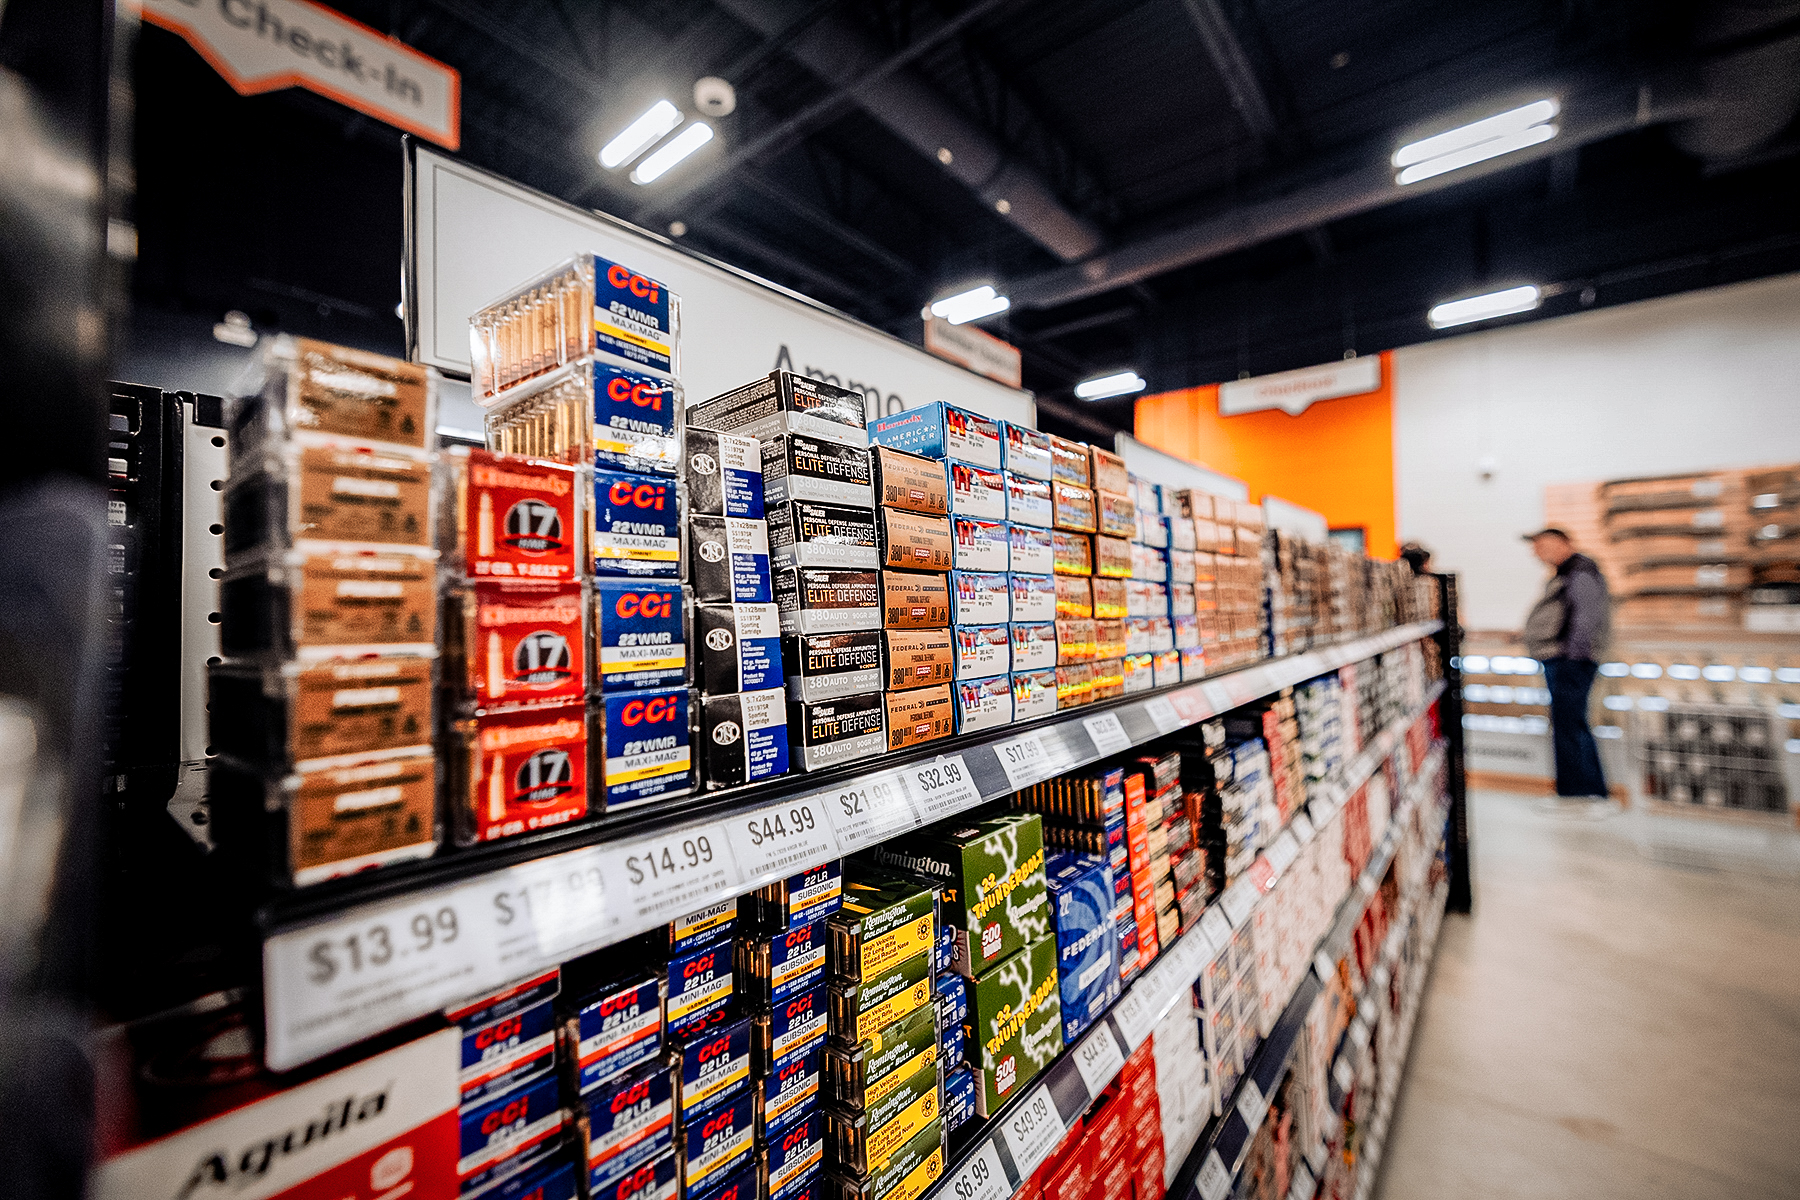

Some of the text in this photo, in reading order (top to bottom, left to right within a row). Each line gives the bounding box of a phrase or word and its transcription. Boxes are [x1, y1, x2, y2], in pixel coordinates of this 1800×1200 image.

[217, 0, 424, 108] Check-In
[877, 414, 921, 432] Hornady
[796, 457, 868, 479] ELITE DEFENSE
[517, 504, 557, 536] 17
[804, 523, 874, 540] ELITE DEFENSE
[808, 590, 877, 602] ELITE DEFENSE
[526, 636, 566, 670] 17
[809, 651, 877, 669] ELITE DEFENSE
[891, 704, 917, 713] FEDERAL
[813, 714, 880, 739] ELITE DEFENSE
[813, 745, 833, 758] 380
[1007, 741, 1040, 764] $17.99
[530, 752, 568, 788] 17
[918, 763, 962, 793] $32.99
[840, 783, 894, 818] $21.99
[748, 806, 814, 849] $44.99
[626, 836, 713, 884] $14.99
[874, 844, 951, 876] Remington
[798, 881, 833, 900] SUBSONIC
[804, 871, 827, 887] 22 LR
[972, 848, 1043, 919] THUNDERBOLT
[982, 873, 997, 893] 22
[493, 866, 605, 925] $1799
[686, 905, 726, 926] MINI-MAG
[864, 905, 907, 930] Remington
[308, 906, 459, 984] $13.99
[982, 923, 1000, 946] 500
[1062, 922, 1108, 961] FEDERAL
[781, 951, 818, 974] SUBSONIC
[787, 941, 811, 960] 22 LR
[680, 981, 722, 1006] MINI-MAG
[684, 970, 714, 992] 22 LR
[860, 973, 902, 1002] Remington
[788, 1010, 813, 1030] 22 LR
[987, 967, 1058, 1055] THUNDERBOLT
[996, 1004, 1012, 1028] 22
[781, 1020, 819, 1045] SUBSONIC
[699, 1052, 730, 1077] 22 LR
[867, 1041, 909, 1074] Remington
[996, 1056, 1015, 1082] 500
[695, 1062, 738, 1091] MINI-MAG
[780, 1070, 805, 1093] 22 LR
[774, 1079, 811, 1108] SUBSONIC
[870, 1086, 911, 1124] Remington
[1014, 1097, 1047, 1141] $49.99
[173, 1082, 388, 1200] Aguila
[699, 1134, 741, 1167] MINI-MAG
[703, 1126, 733, 1153] 22 LR
[784, 1138, 809, 1163] 22 LR
[777, 1147, 815, 1179] SUBSONIC
[955, 1157, 989, 1200] $6.99
